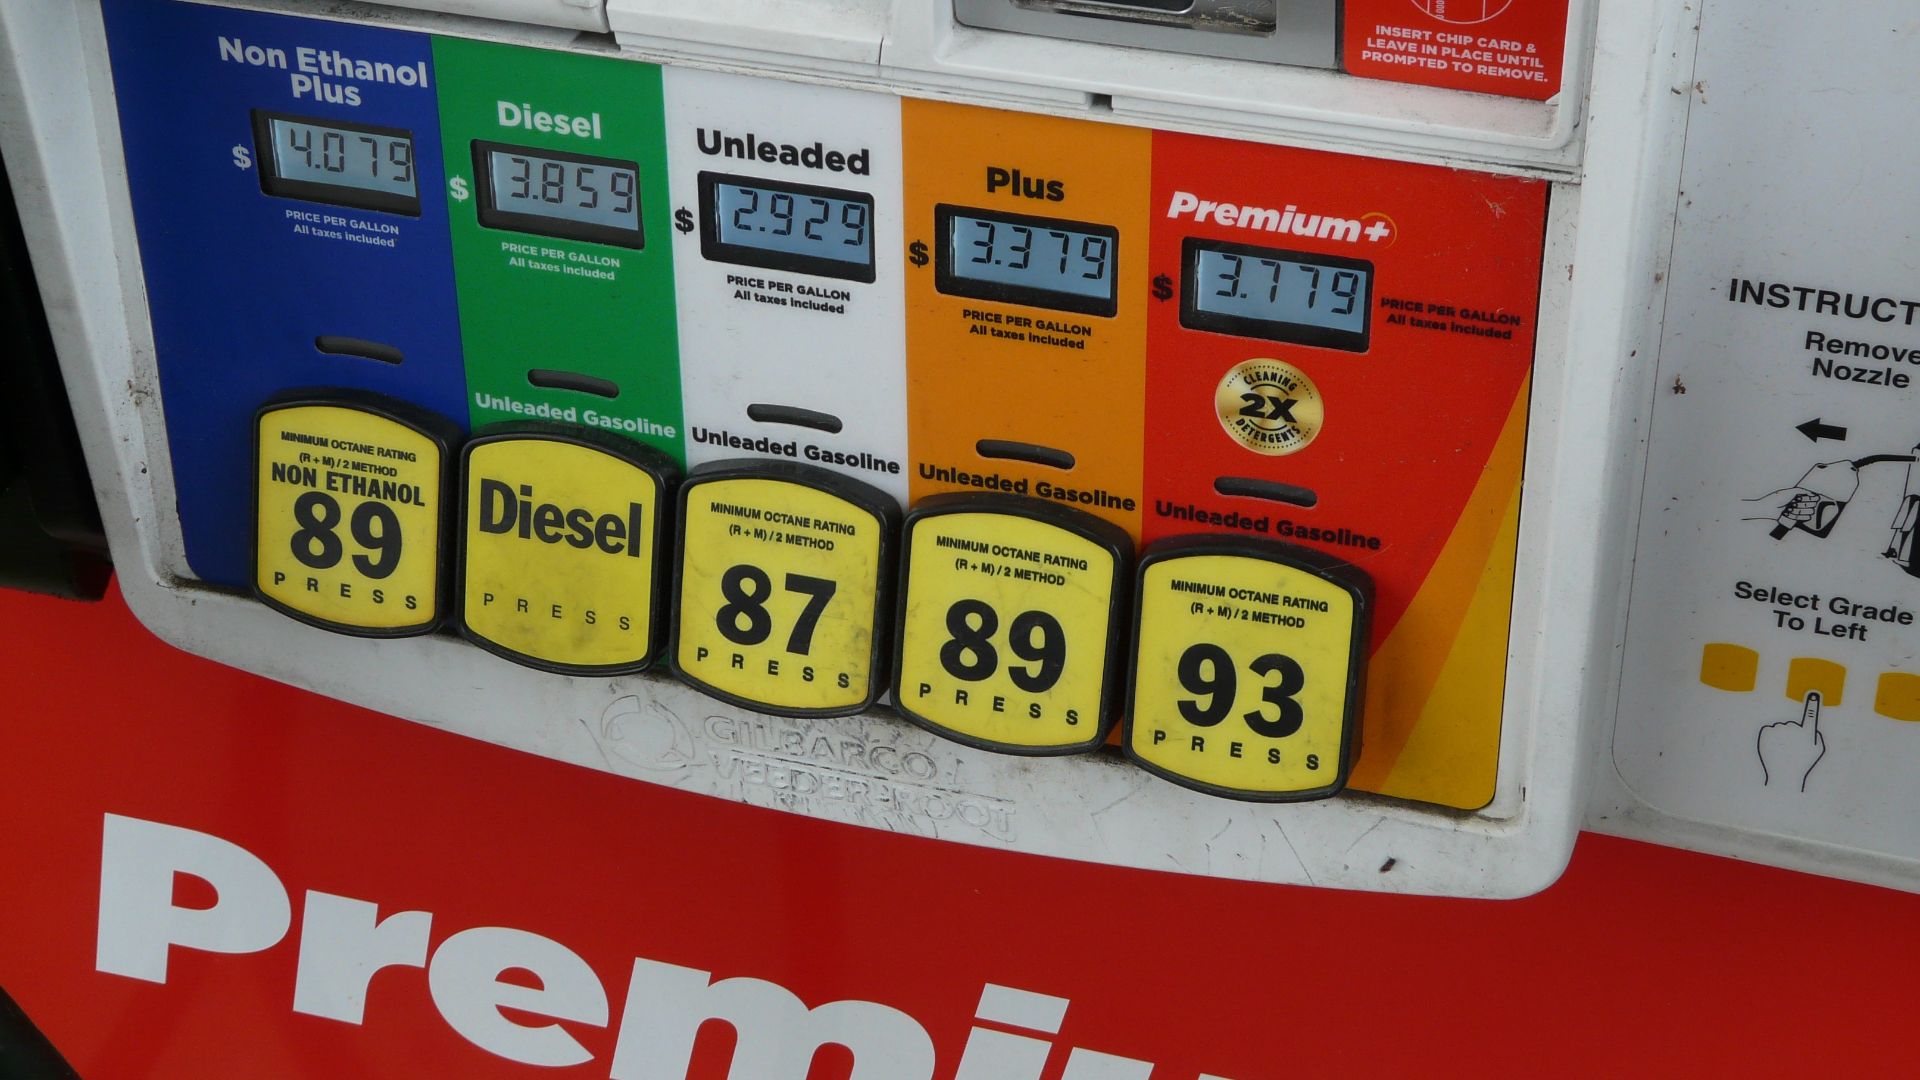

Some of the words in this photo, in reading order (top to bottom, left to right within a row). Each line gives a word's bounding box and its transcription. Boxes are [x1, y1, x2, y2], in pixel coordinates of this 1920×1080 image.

[1367, 37, 1417, 53] LEAVE
[1421, 44, 1437, 55] IN
[1442, 47, 1492, 62] PLACE
[1496, 53, 1544, 68] UNTIL
[1376, 25, 1432, 41] INSERT
[1436, 32, 1473, 45] CHIP
[1477, 37, 1522, 52] CARD
[1526, 43, 1536, 54] &
[218, 36, 286, 69] Non
[297, 47, 428, 88] Ethanol
[1361, 50, 1448, 70] PROMPTED
[1452, 61, 1473, 72] TO
[1477, 64, 1548, 82] REMOVE.
[291, 73, 361, 106] Plus
[497, 101, 601, 140] Diesel
[232, 144, 251, 170] $
[290, 128, 411, 182] 4.079
[696, 127, 870, 176] Unleaded
[450, 175, 469, 202] $
[511, 158, 634, 213] 3.859
[986, 166, 1065, 202] Plus
[286, 210, 320, 223] PRICE
[324, 216, 346, 227] PER
[350, 220, 399, 234] GALLON
[675, 207, 694, 234] $
[734, 189, 866, 246] 2.929
[294, 225, 309, 234] All
[312, 227, 342, 239] taxes
[345, 232, 395, 247] included
[971, 222, 1106, 280] 3.379
[502, 242, 538, 255] PRICE
[541, 248, 565, 259] PER
[569, 252, 620, 267] GALLON
[509, 257, 525, 267] All
[528, 260, 560, 272] taxes
[563, 264, 615, 280] included
[909, 239, 929, 267] $
[727, 275, 764, 289] PRICE
[768, 281, 793, 293] PER
[797, 285, 850, 301] GALLON
[1152, 273, 1173, 302] $
[1215, 254, 1358, 315] 3.779
[734, 290, 750, 301] All
[754, 292, 787, 306] taxes
[791, 297, 844, 314] included
[1380, 297, 1423, 312] PRICE
[1428, 304, 1455, 317] PER
[1460, 309, 1520, 326] GALLON
[963, 309, 1002, 324] PRICE
[1006, 316, 1032, 328] PER
[1036, 320, 1091, 336] GALLON
[970, 324, 986, 335] All
[990, 327, 1024, 340] taxes
[1029, 332, 1084, 349] included
[1387, 314, 1405, 325] All
[1410, 316, 1446, 331] taxes
[1451, 322, 1512, 340] included
[1805, 331, 1920, 365] Remove
[1243, 371, 1298, 392] CLEANING
[1812, 357, 1910, 388] Nozzle
[476, 392, 577, 423] Unleaded
[583, 410, 676, 438] Gasoline
[1239, 393, 1298, 423] 2X
[281, 431, 328, 448] MINIMUM
[331, 439, 374, 455] OCTANE
[377, 447, 416, 462] RATING
[1236, 418, 1300, 443] DETERGENTS
[692, 427, 797, 457] Unleaded
[804, 444, 900, 474] Gasoline
[272, 462, 316, 488] NON
[326, 471, 425, 507] ETHANOL
[343, 460, 350, 469] 2
[351, 461, 397, 477] METHOD
[919, 463, 1028, 494] Unleaded
[1036, 481, 1136, 511] Gasoline
[479, 478, 642, 558] Diesel
[710, 502, 761, 520] MINIMUM
[764, 511, 810, 528] OCTANE
[813, 519, 856, 536] RATING
[1155, 500, 1269, 532] Unleaded
[1276, 520, 1381, 550] Gasoline
[290, 491, 403, 580] 89
[776, 532, 783, 542] 2
[785, 534, 834, 551] METHOD
[936, 536, 989, 554] MINIMUM
[992, 545, 1040, 562] OCTANE
[1043, 554, 1088, 571] RATING
[1004, 566, 1011, 576] 2
[1014, 569, 1065, 586] METHOD
[716, 563, 837, 656] 87
[1171, 579, 1226, 597] MINIMUM
[1229, 588, 1280, 605] OCTANE
[1282, 596, 1329, 613] RATING
[1734, 581, 1820, 611] Select
[1828, 597, 1914, 625] Grade
[1241, 610, 1249, 620] 2
[1252, 612, 1305, 629] METHOD
[1773, 610, 1804, 631] To
[1814, 617, 1868, 642] Left
[939, 599, 1067, 693] 89
[1177, 642, 1305, 738] 93
[703, 715, 938, 780] GILBARCO
[95, 812, 1236, 1080] Premi
